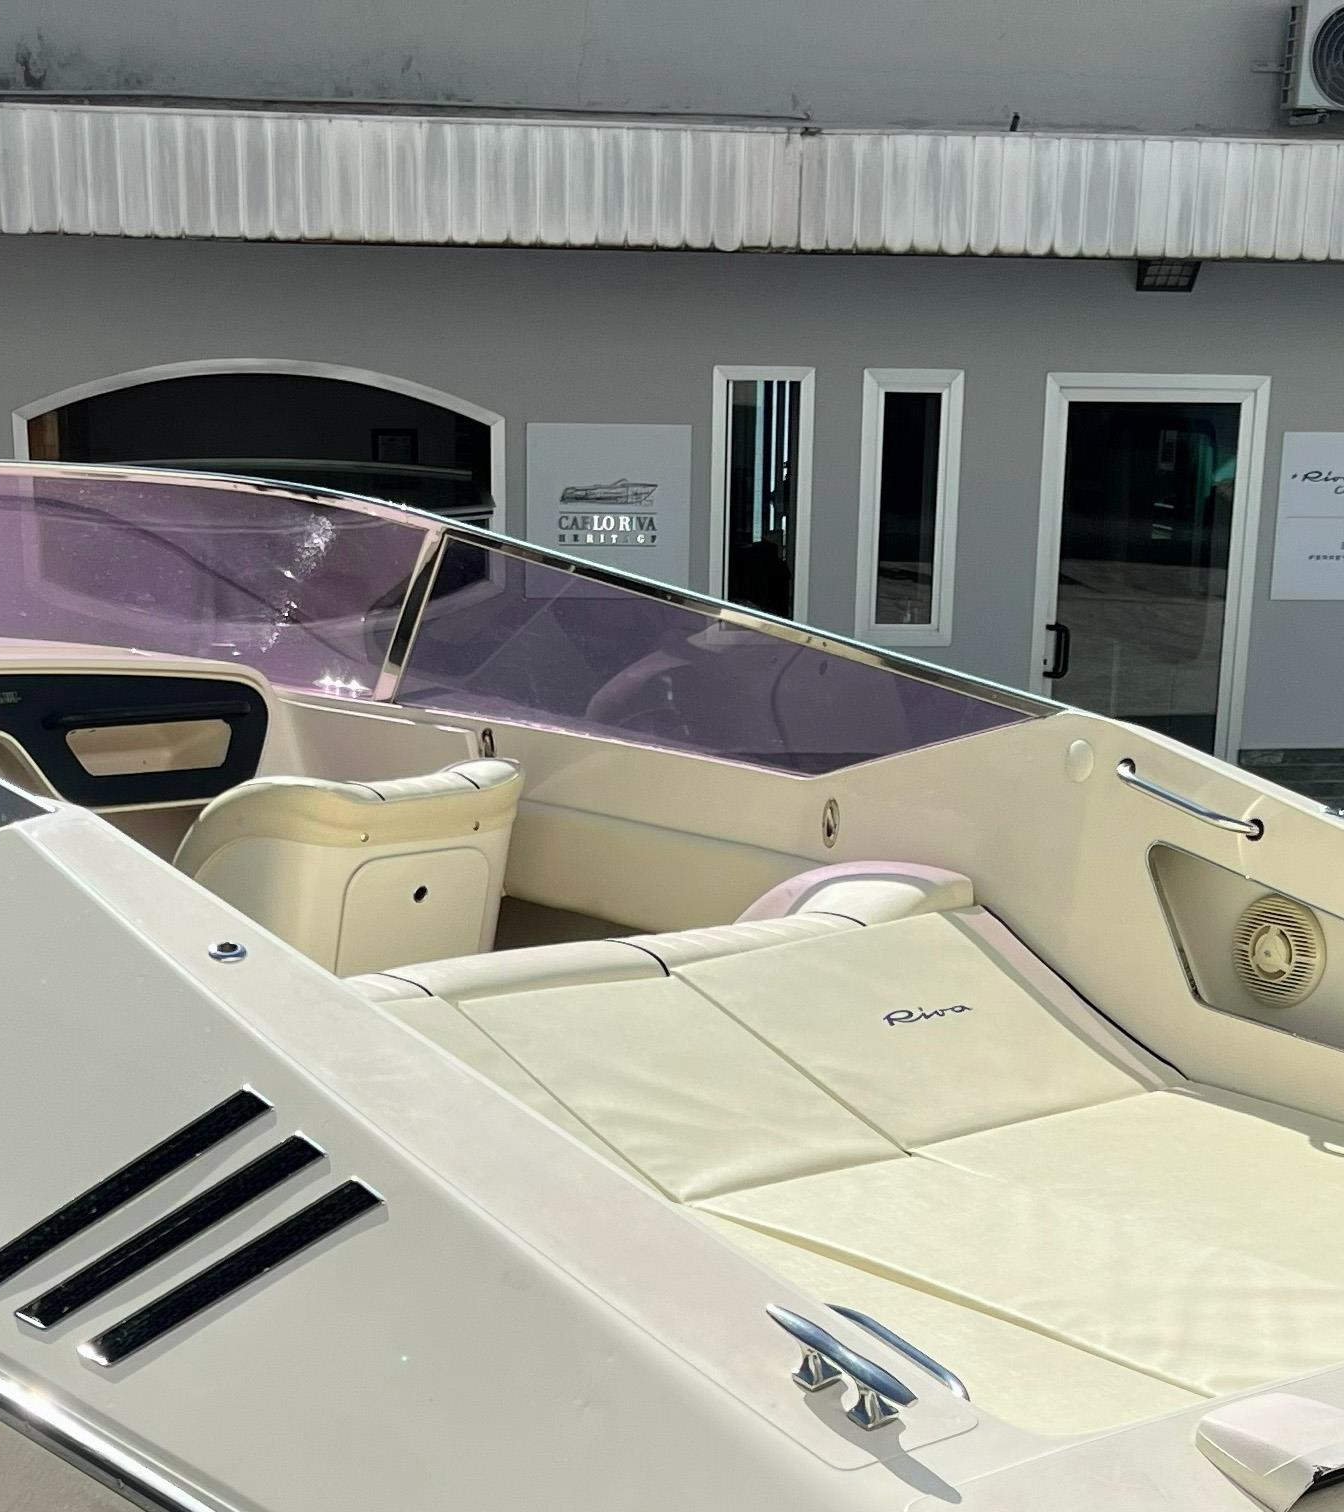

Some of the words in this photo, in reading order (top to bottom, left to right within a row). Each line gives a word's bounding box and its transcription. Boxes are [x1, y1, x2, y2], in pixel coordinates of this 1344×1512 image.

[558, 515, 615, 531] CARLO
[618, 515, 658, 532] RIVA
[558, 533, 657, 544] HERITAGE
[882, 1005, 974, 1027] Riva
